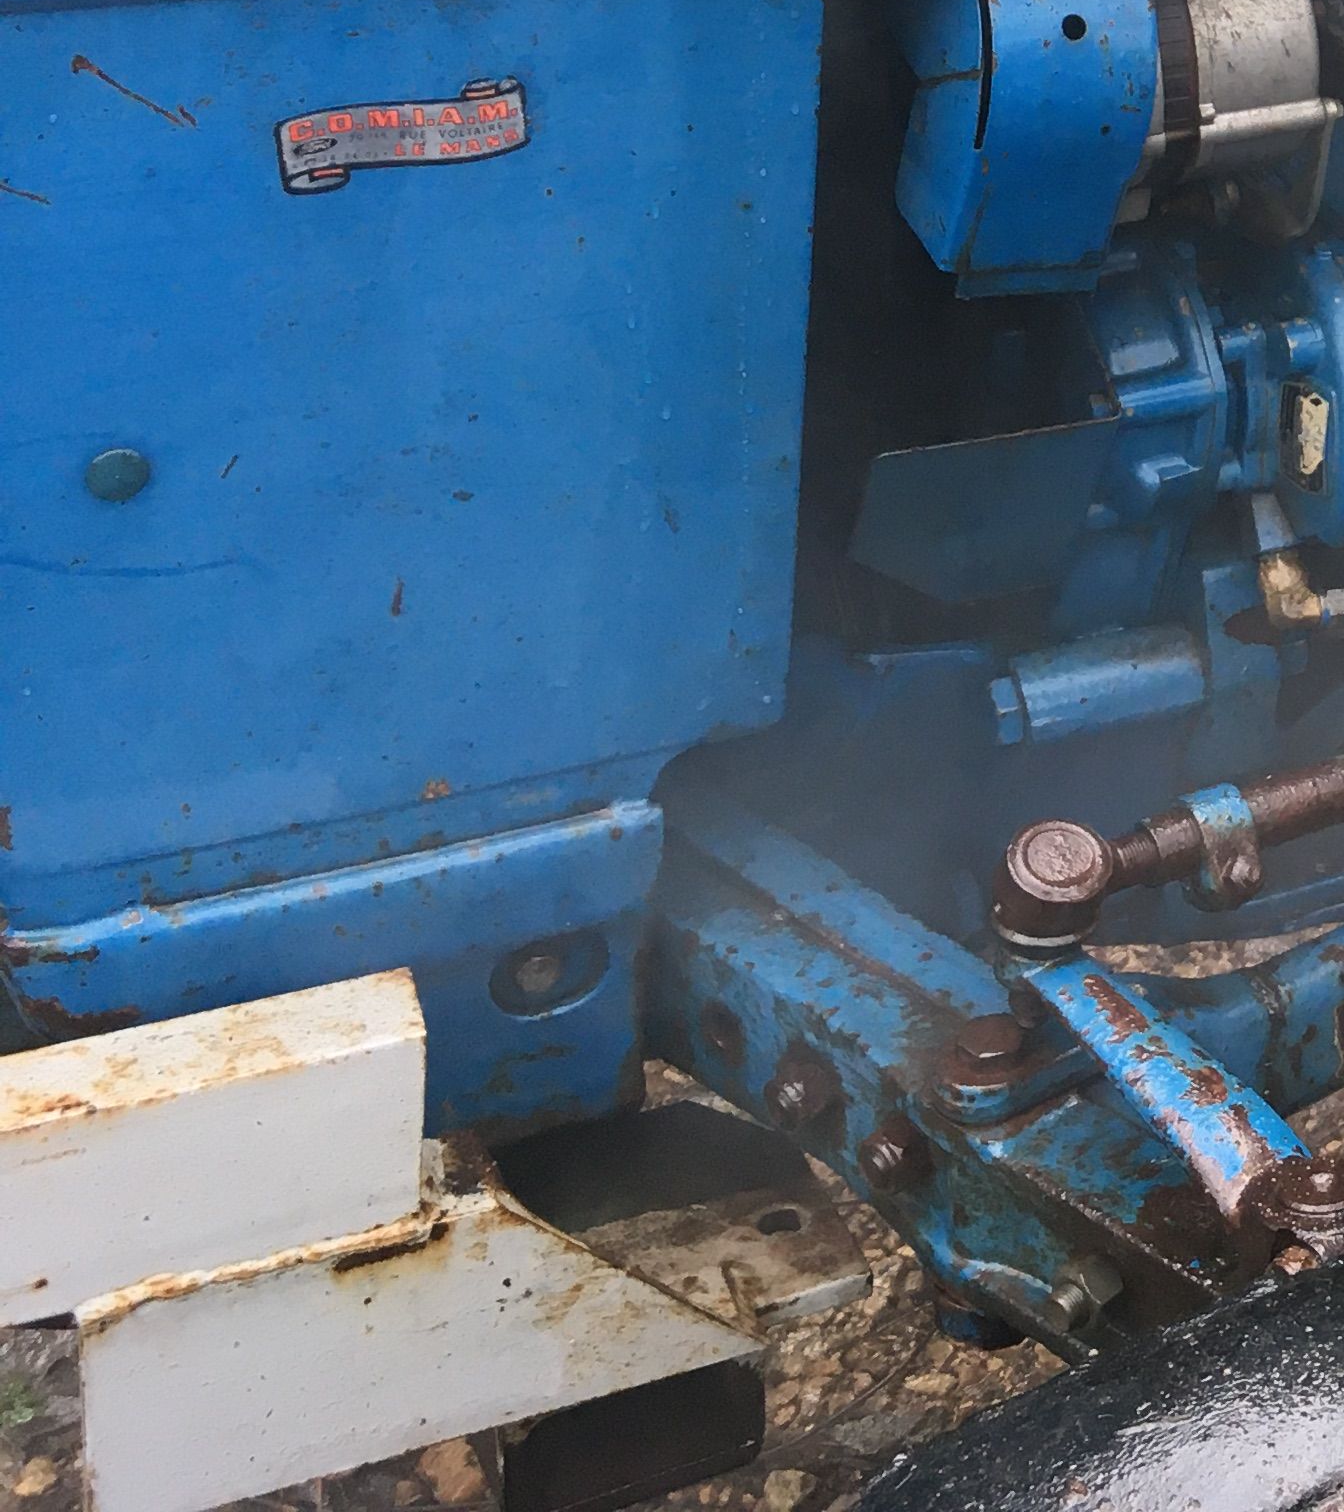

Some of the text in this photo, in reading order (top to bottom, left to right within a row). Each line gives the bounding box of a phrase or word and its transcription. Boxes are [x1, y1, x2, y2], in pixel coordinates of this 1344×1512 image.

[289, 99, 518, 143] C.O.M.I.A.M.
[399, 129, 427, 140] RUE
[438, 122, 503, 139] VOLTAIRE
[394, 127, 519, 156] LE MANS
